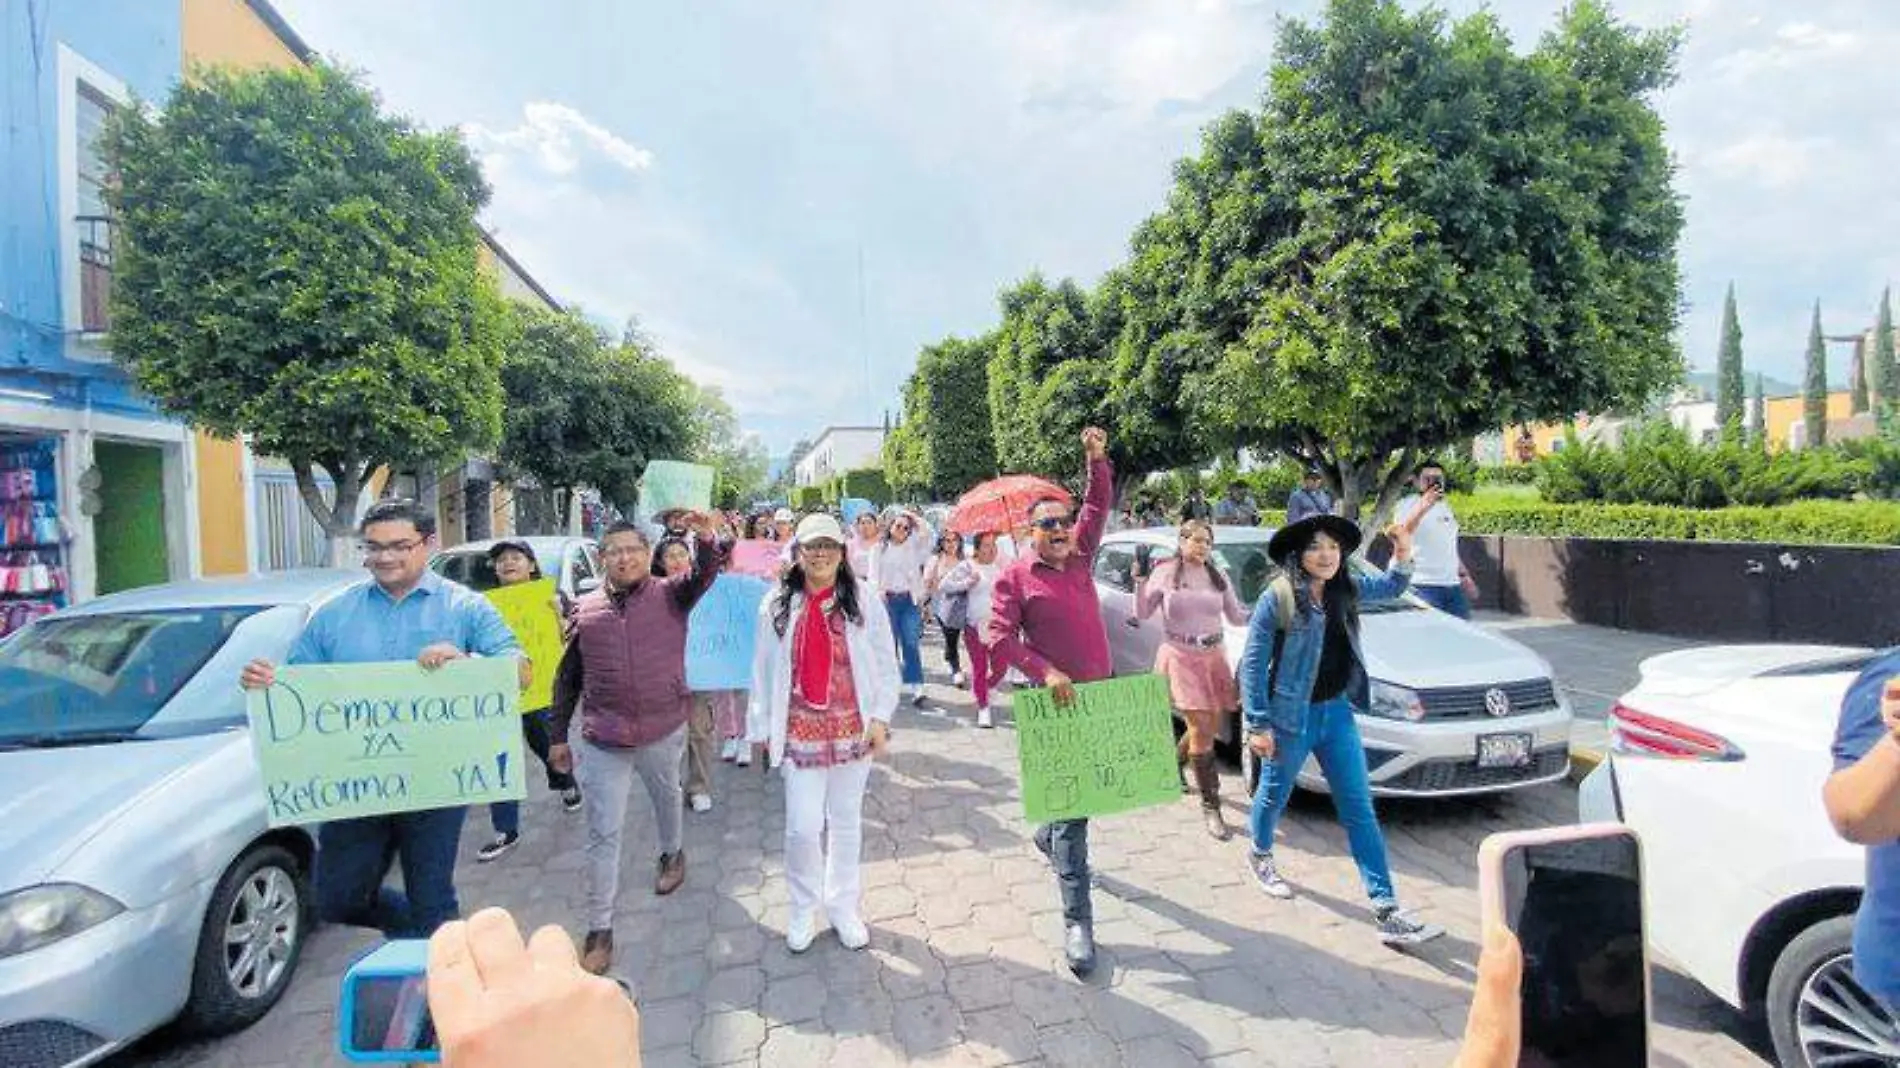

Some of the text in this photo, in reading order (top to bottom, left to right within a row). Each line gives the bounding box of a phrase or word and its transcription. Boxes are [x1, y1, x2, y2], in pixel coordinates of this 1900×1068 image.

[265, 680, 506, 742] Democracia
[363, 732, 404, 756] YA
[267, 773, 409, 817] Reforma
